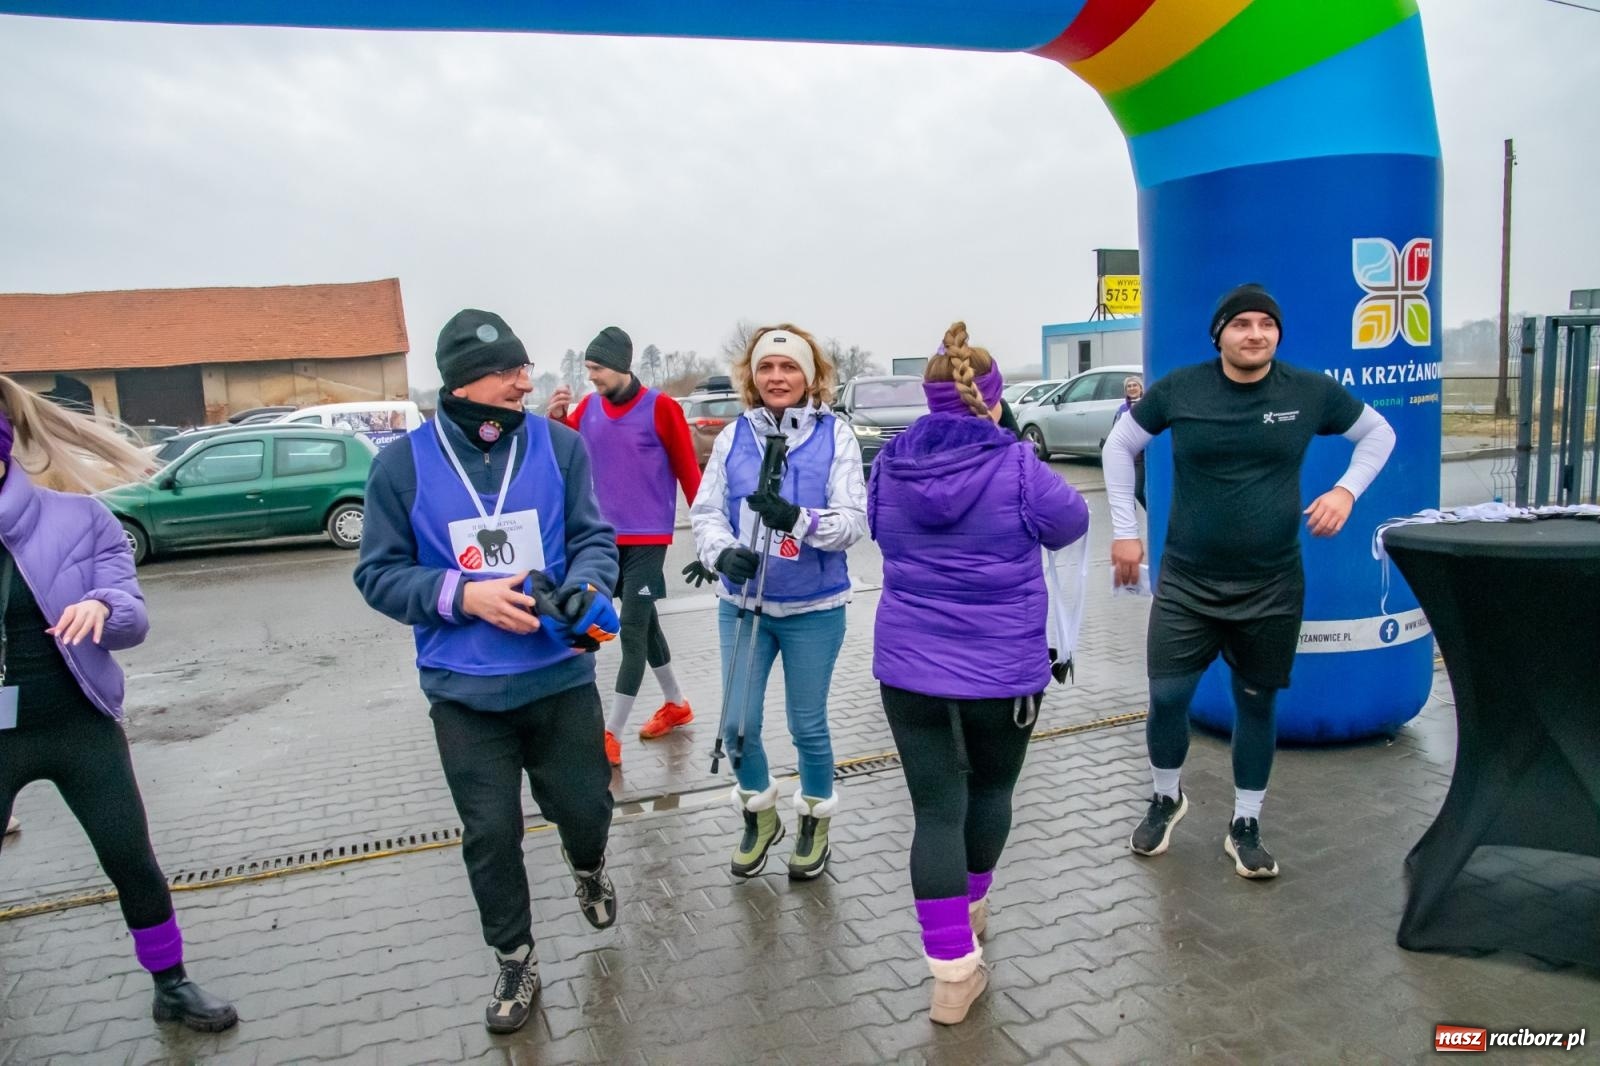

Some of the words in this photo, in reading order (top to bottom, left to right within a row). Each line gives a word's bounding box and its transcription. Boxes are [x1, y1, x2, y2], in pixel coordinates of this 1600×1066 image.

[1106, 288, 1128, 302] 575
[1132, 288, 1142, 302] 7
[1373, 397, 1404, 409] poznaj
